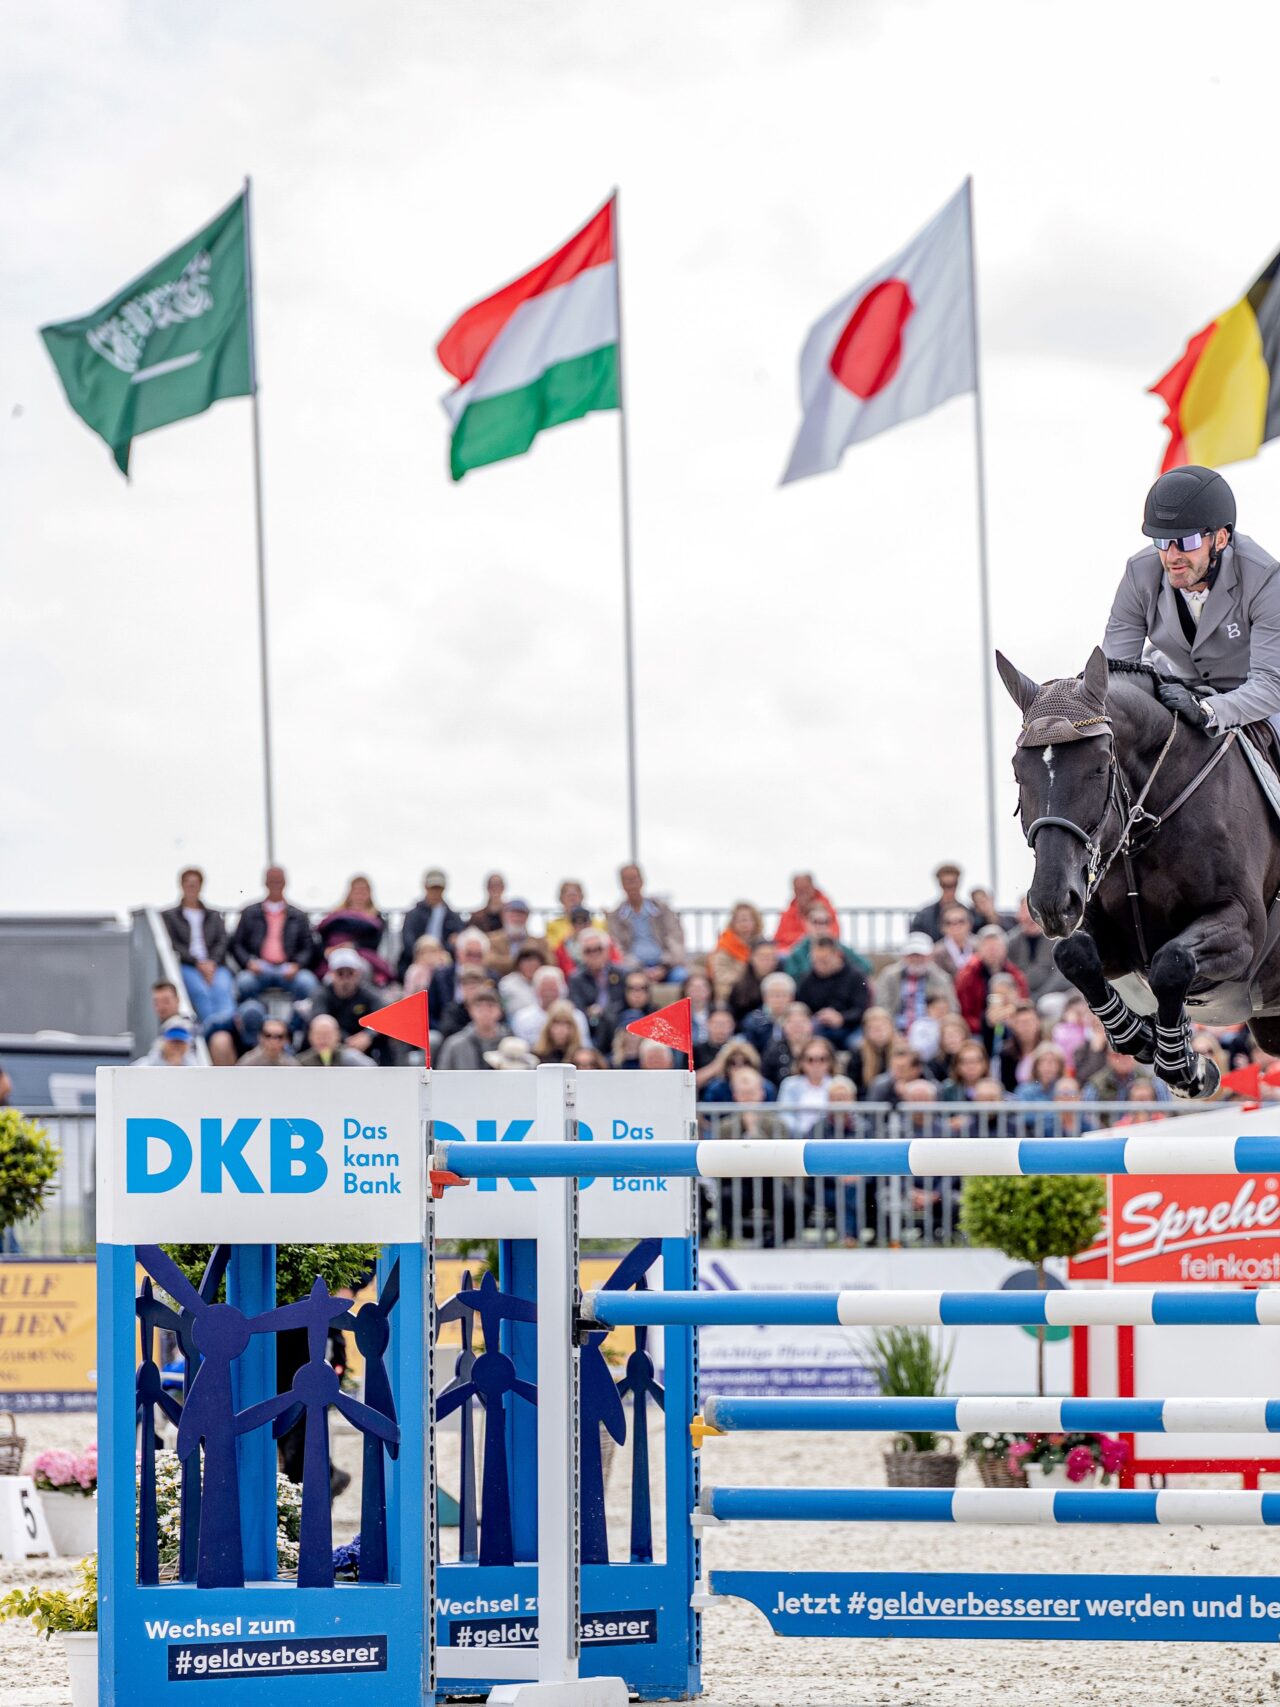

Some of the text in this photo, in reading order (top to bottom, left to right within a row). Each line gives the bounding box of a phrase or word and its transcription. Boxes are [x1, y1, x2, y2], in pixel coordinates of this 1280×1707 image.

[343, 1118, 388, 1140] Das
[612, 1119, 655, 1140] Das
[126, 1118, 329, 1193] DKB
[343, 1145, 400, 1167] kann
[343, 1172, 402, 1194] Bank
[436, 1593, 519, 1615] Wechsel
[773, 1591, 841, 1615] Jetzt
[847, 1591, 1081, 1621] #geldverbesserer
[1085, 1593, 1185, 1618] werden
[1192, 1594, 1242, 1618] und
[145, 1616, 296, 1640] Wechsel zum
[175, 1645, 379, 1675] #geldverbesserer
